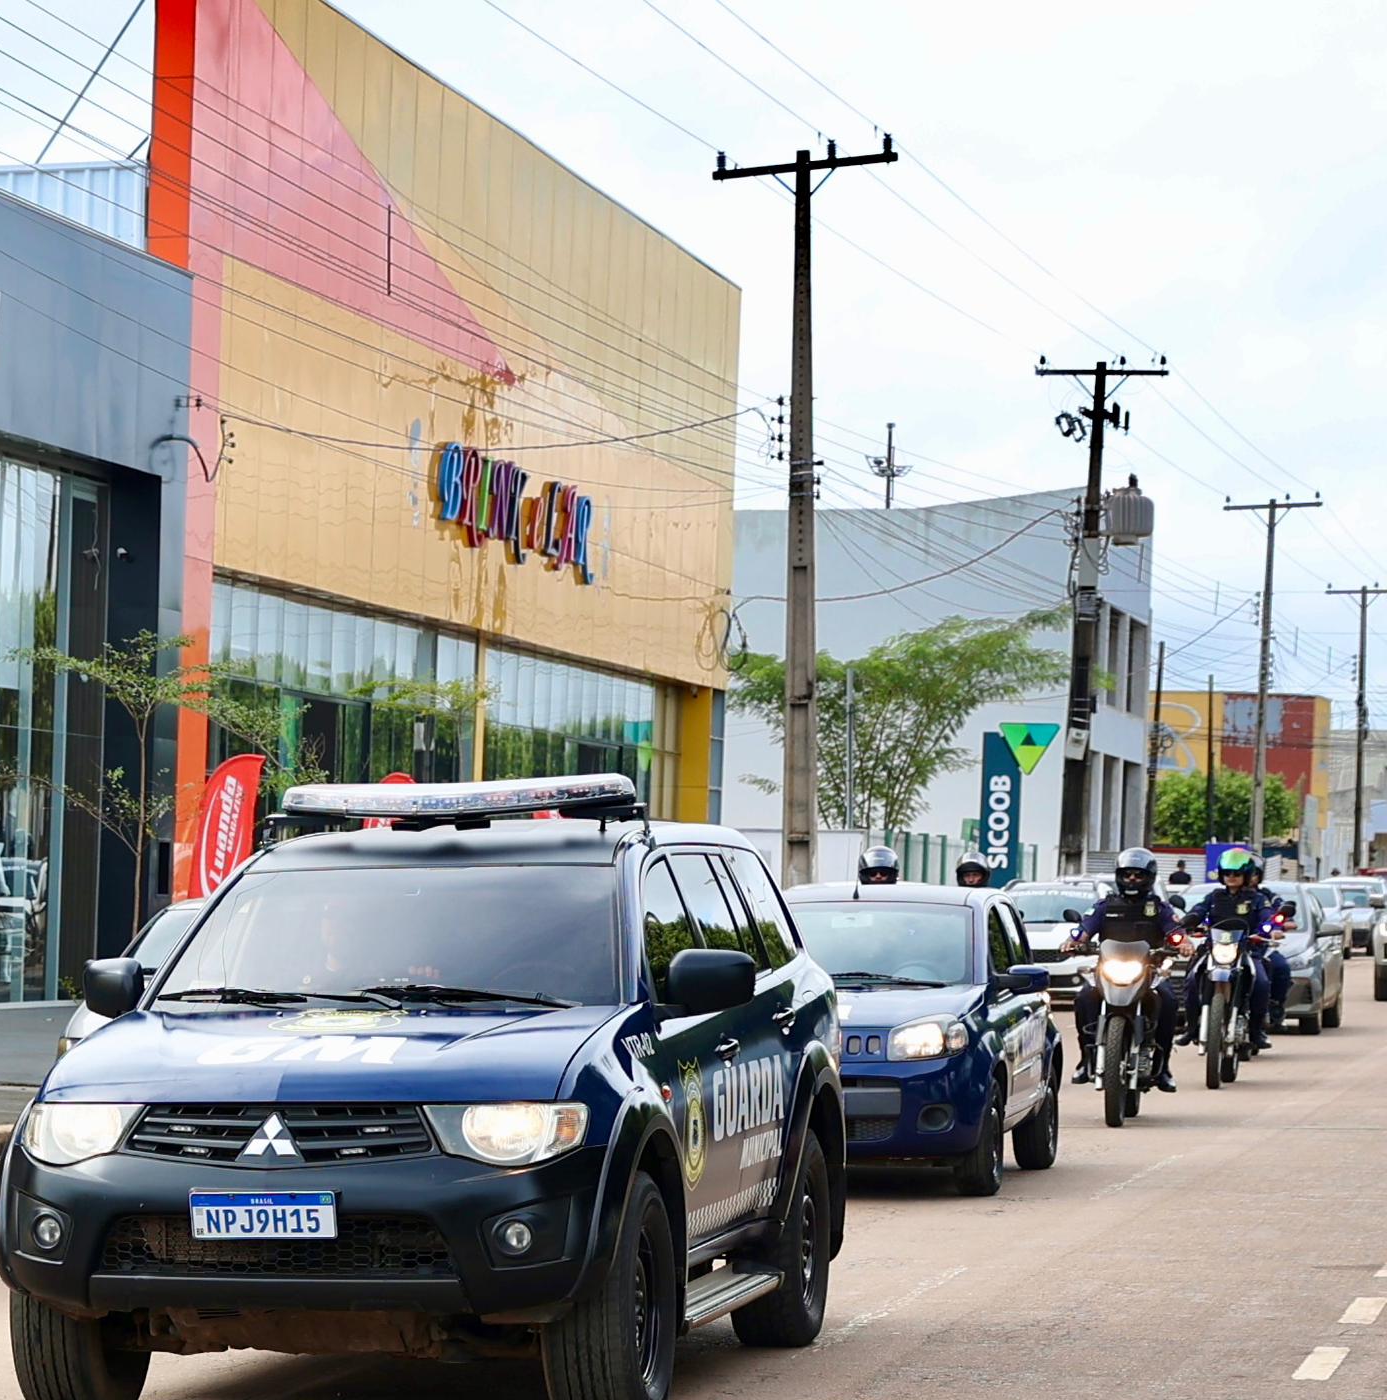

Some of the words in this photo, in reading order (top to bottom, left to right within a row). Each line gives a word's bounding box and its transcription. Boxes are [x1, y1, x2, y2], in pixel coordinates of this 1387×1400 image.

[209, 774, 238, 885] Luanda
[987, 774, 1012, 870] SICOOB
[196, 1035, 408, 1065] GM
[712, 1053, 785, 1142] GUARDA
[739, 1127, 783, 1171] MUNICIPAL
[205, 1208, 321, 1234] NPJ9H15
